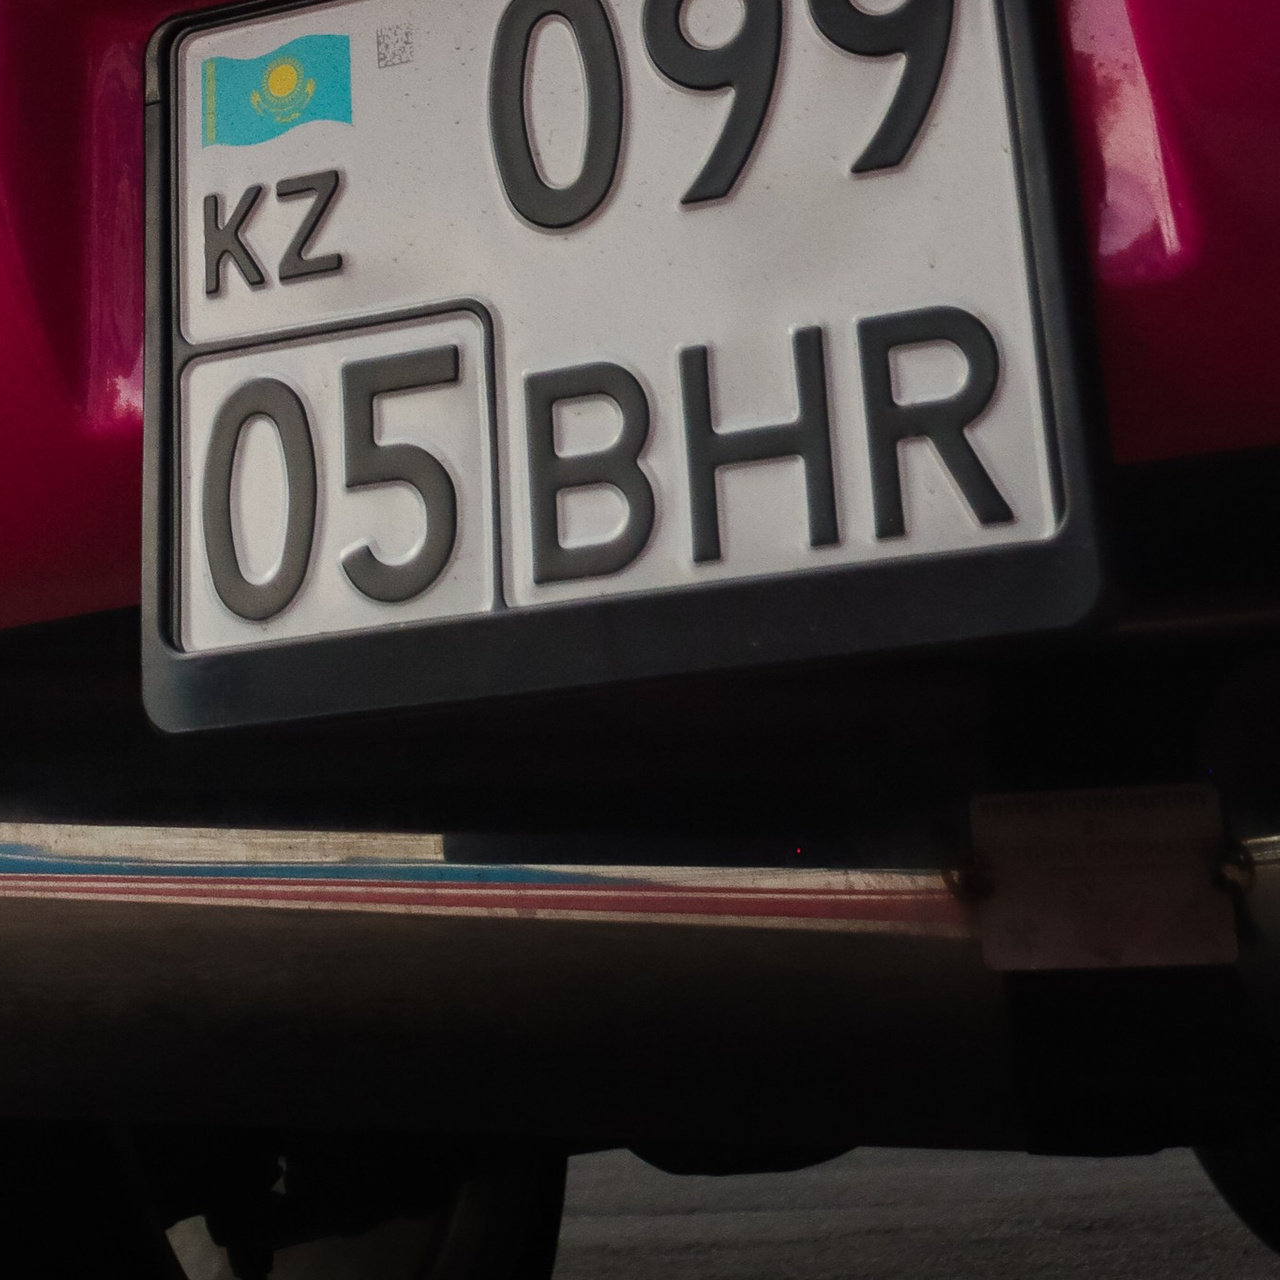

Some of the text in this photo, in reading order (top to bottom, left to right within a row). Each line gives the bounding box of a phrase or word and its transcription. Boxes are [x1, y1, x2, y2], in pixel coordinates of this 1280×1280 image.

[202, 169, 344, 297] KZ
[202, 304, 1016, 622] 05 BHR
